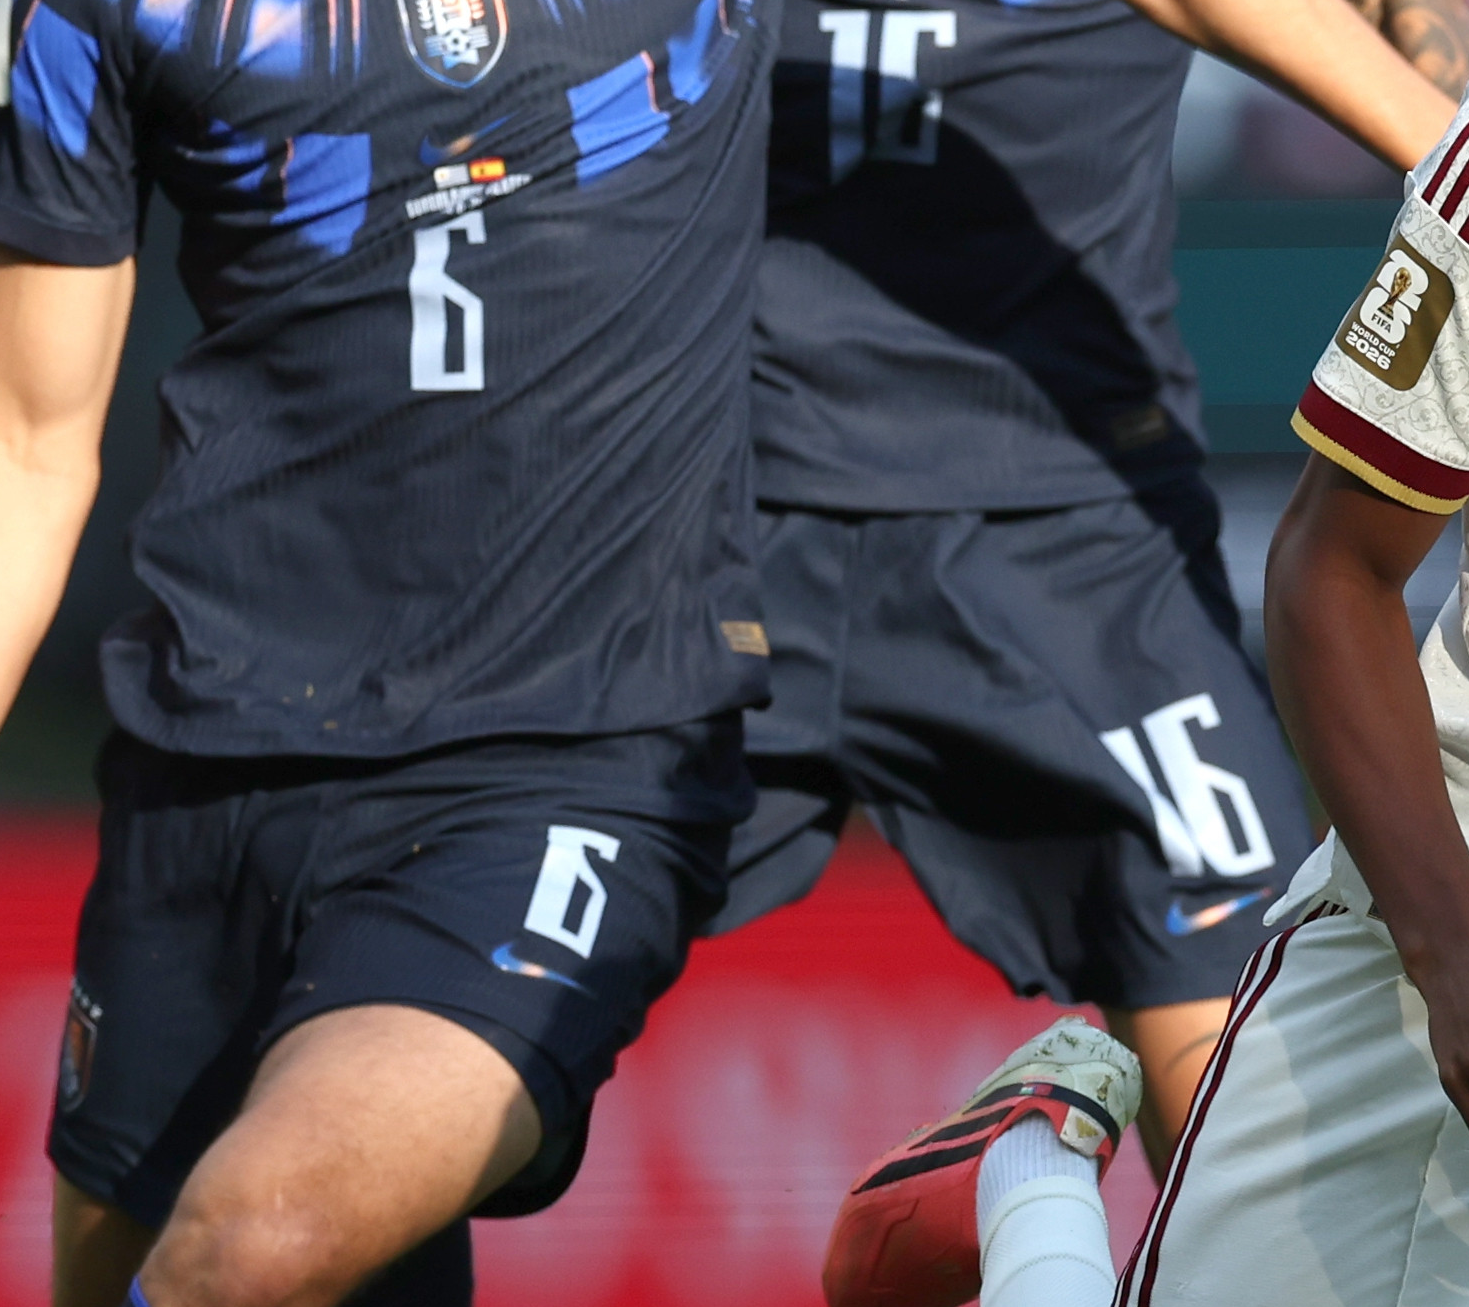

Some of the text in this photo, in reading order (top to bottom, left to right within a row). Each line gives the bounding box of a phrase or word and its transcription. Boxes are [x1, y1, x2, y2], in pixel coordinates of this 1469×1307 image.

[410, 209, 486, 392] 6
[1351, 321, 1396, 358] WORLD CUP
[1370, 313, 1393, 334] FIFA
[1345, 330, 1391, 371] 2026
[1098, 692, 1276, 877] 16
[523, 824, 622, 960] 6
